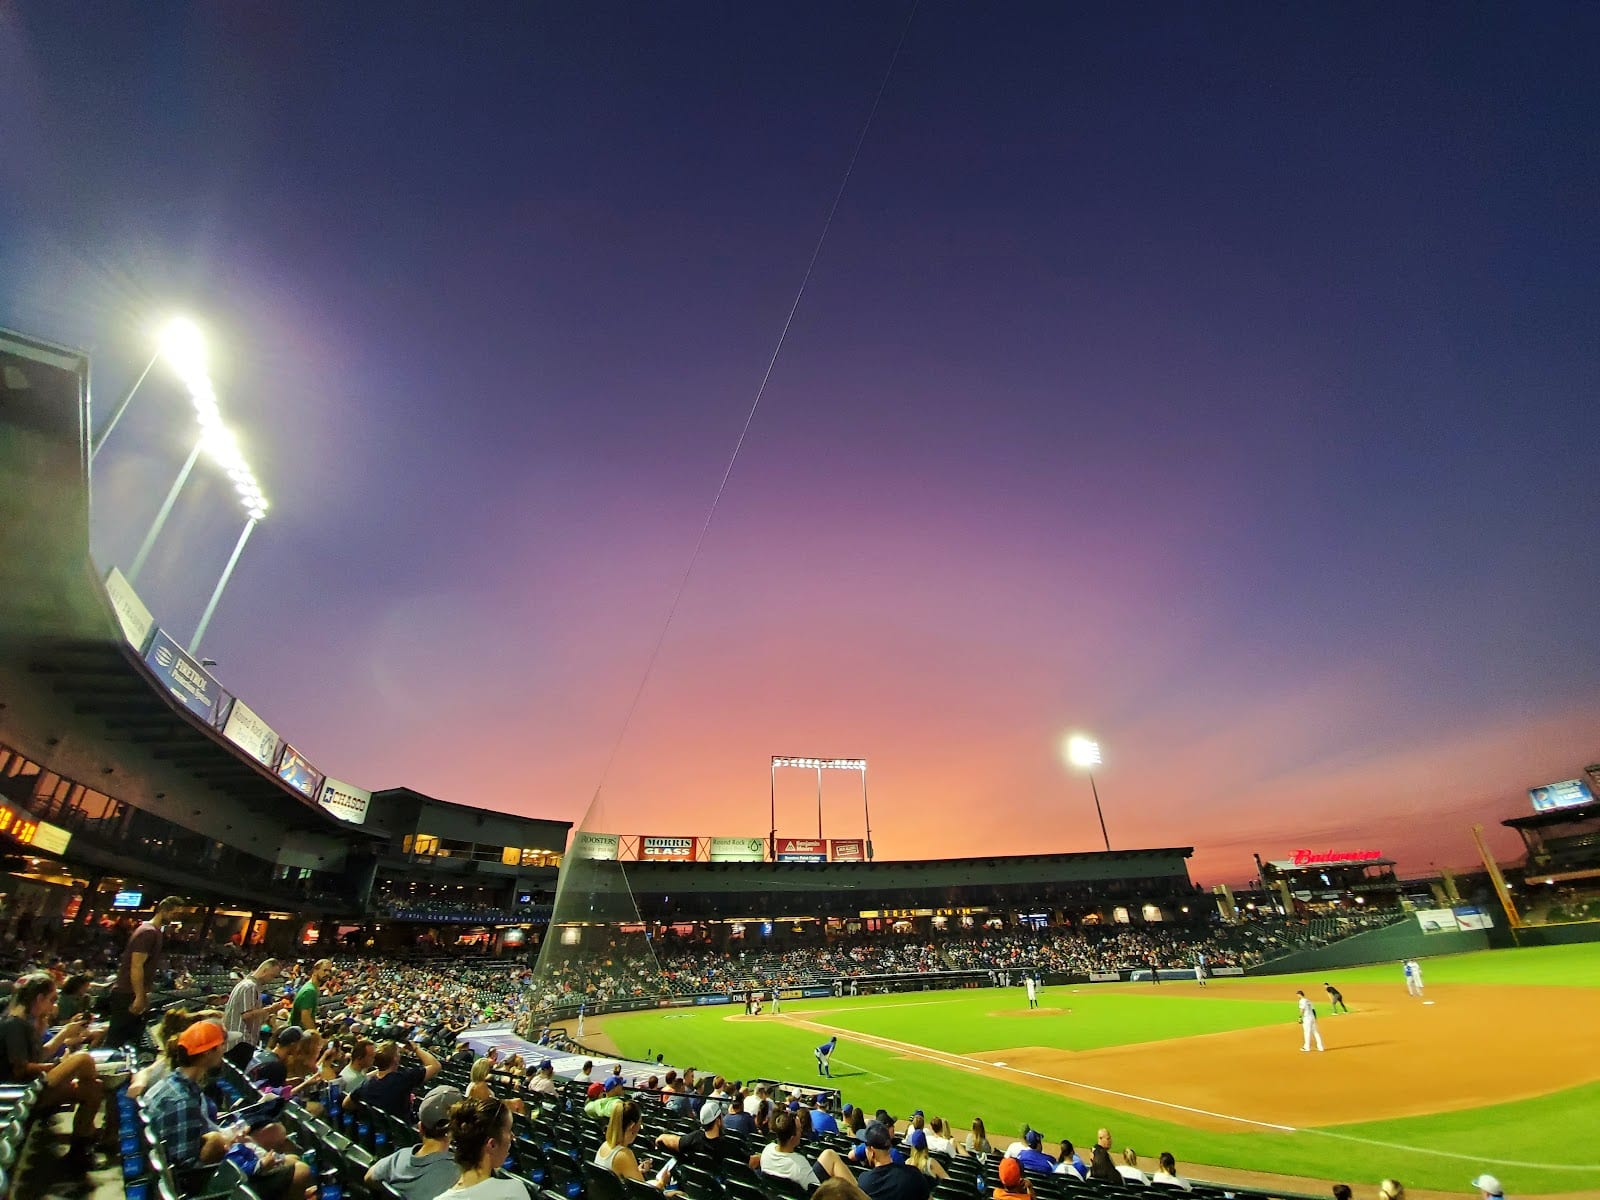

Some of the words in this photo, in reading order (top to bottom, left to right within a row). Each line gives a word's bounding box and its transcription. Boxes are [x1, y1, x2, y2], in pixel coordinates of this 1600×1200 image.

[332, 792, 366, 812] CHASCO
[646, 838, 691, 847] MORRIS
[644, 847, 690, 855] GLASS
[1290, 849, 1382, 866] Budweiser
